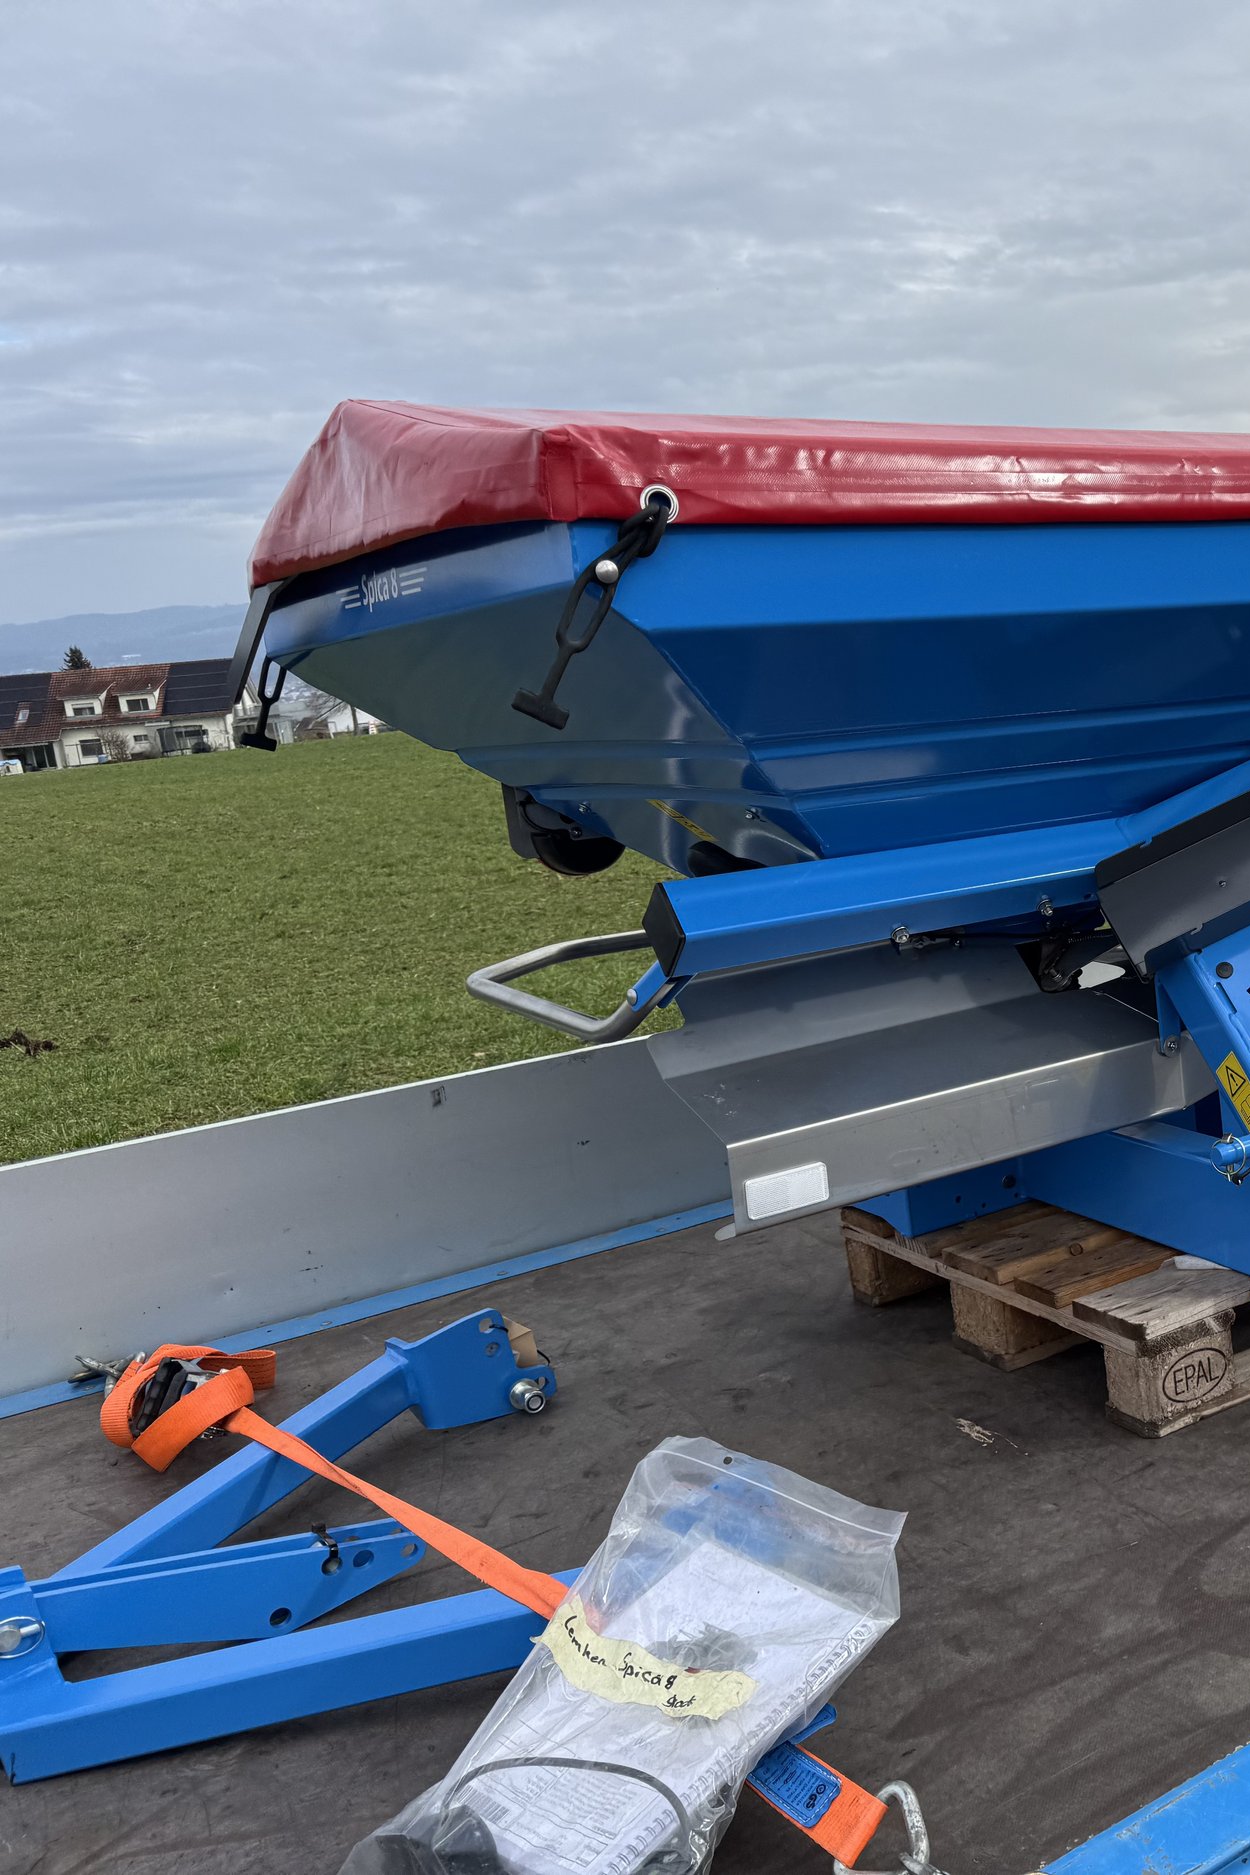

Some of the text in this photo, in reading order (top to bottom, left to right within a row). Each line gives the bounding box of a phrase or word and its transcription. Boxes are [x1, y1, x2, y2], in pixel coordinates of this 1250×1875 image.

[361, 567, 399, 612] Spica 8
[1173, 1357, 1220, 1397] EPAL
[618, 1652, 664, 1686] Spica
